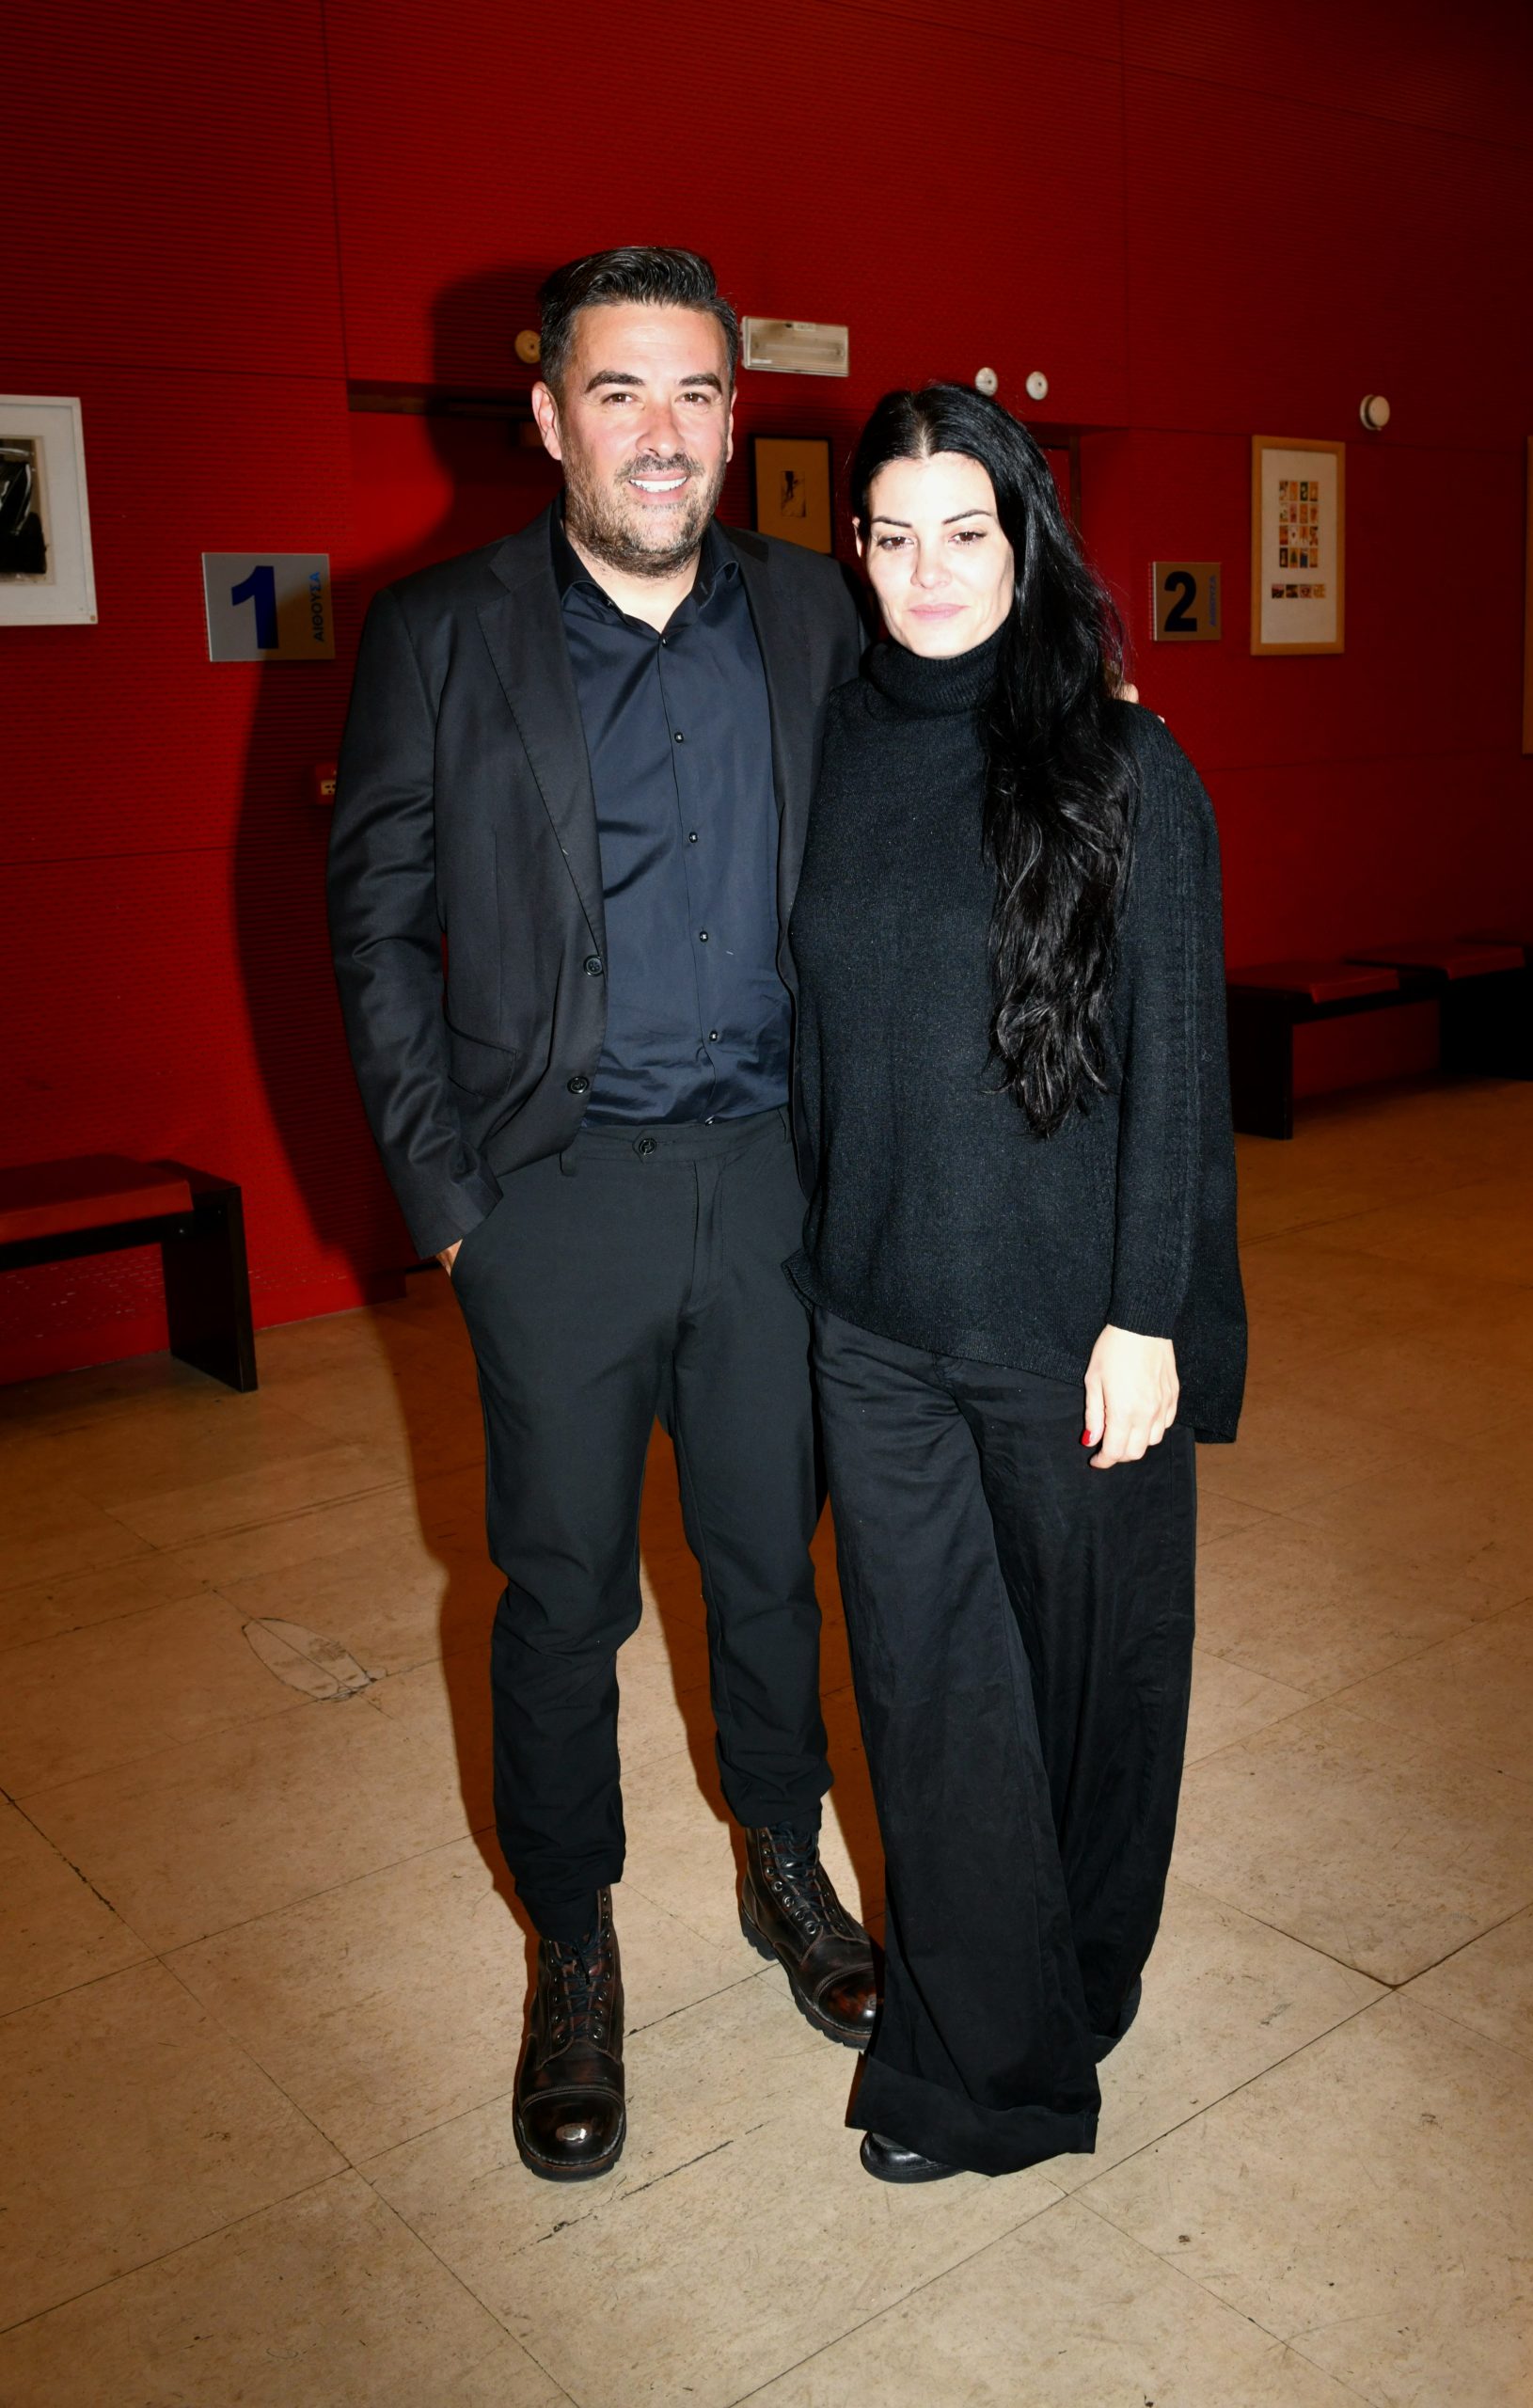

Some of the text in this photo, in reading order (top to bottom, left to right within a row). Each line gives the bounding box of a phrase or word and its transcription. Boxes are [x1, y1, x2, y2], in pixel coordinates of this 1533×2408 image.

[230, 565, 279, 649] 1
[308, 571, 324, 642] ΑΙΘΟΥΣΑ
[1163, 571, 1197, 632] 2
